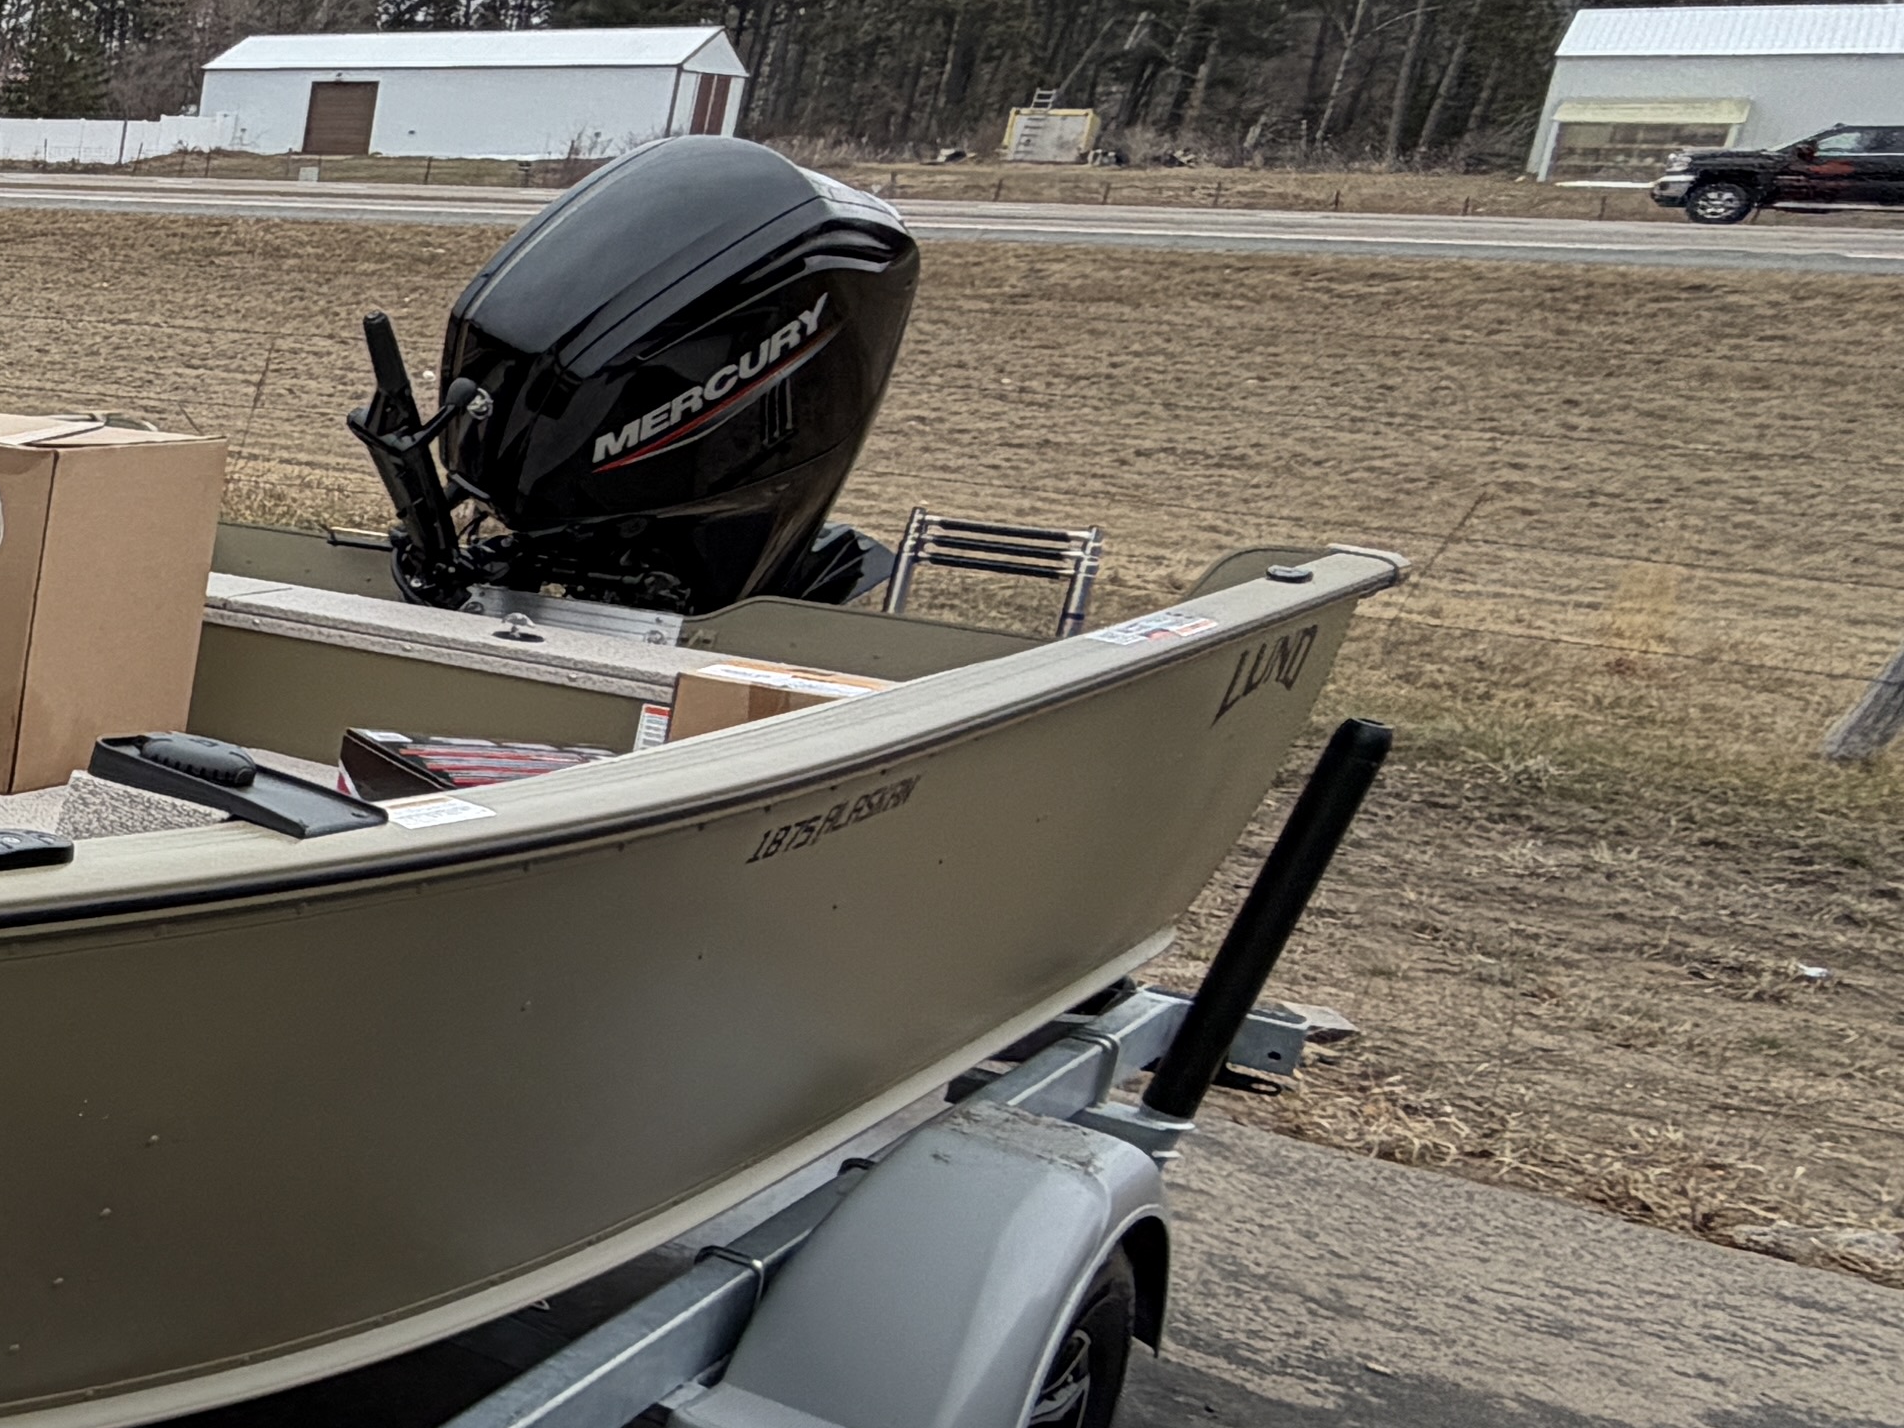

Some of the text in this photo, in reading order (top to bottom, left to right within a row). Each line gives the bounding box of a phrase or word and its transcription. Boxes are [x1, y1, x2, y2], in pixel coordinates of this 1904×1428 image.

[592, 291, 829, 464] MERCURY
[1210, 624, 1319, 730] LUND
[745, 815, 823, 865] 1875
